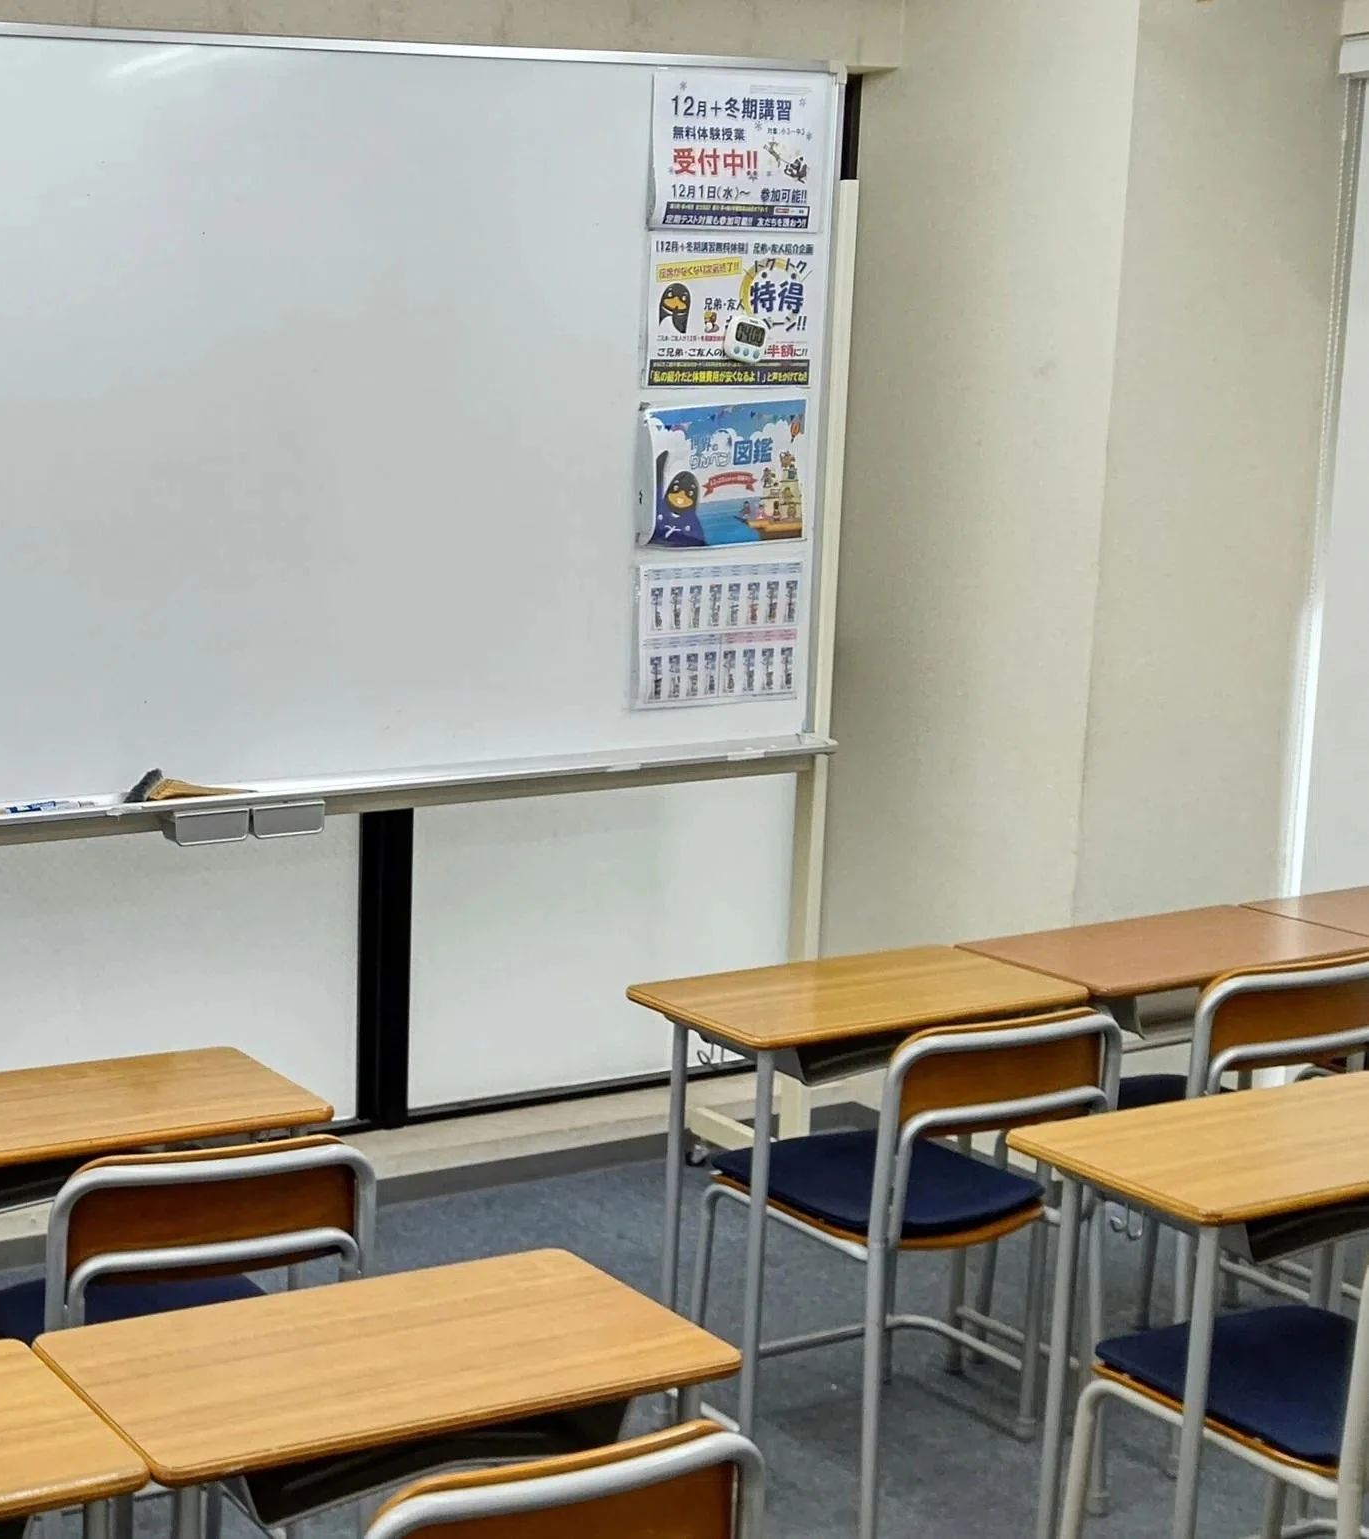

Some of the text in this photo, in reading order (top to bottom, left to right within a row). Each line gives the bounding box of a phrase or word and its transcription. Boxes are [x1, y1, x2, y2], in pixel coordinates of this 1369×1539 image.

[672, 126, 746, 141] 無料体験授業
[673, 148, 759, 177] 受付中!!
[760, 188, 807, 204] 参加可能!!
[703, 298, 745, 312] 兄弟・友人
[750, 281, 805, 315] 特得
[733, 437, 774, 467] 図鑑
